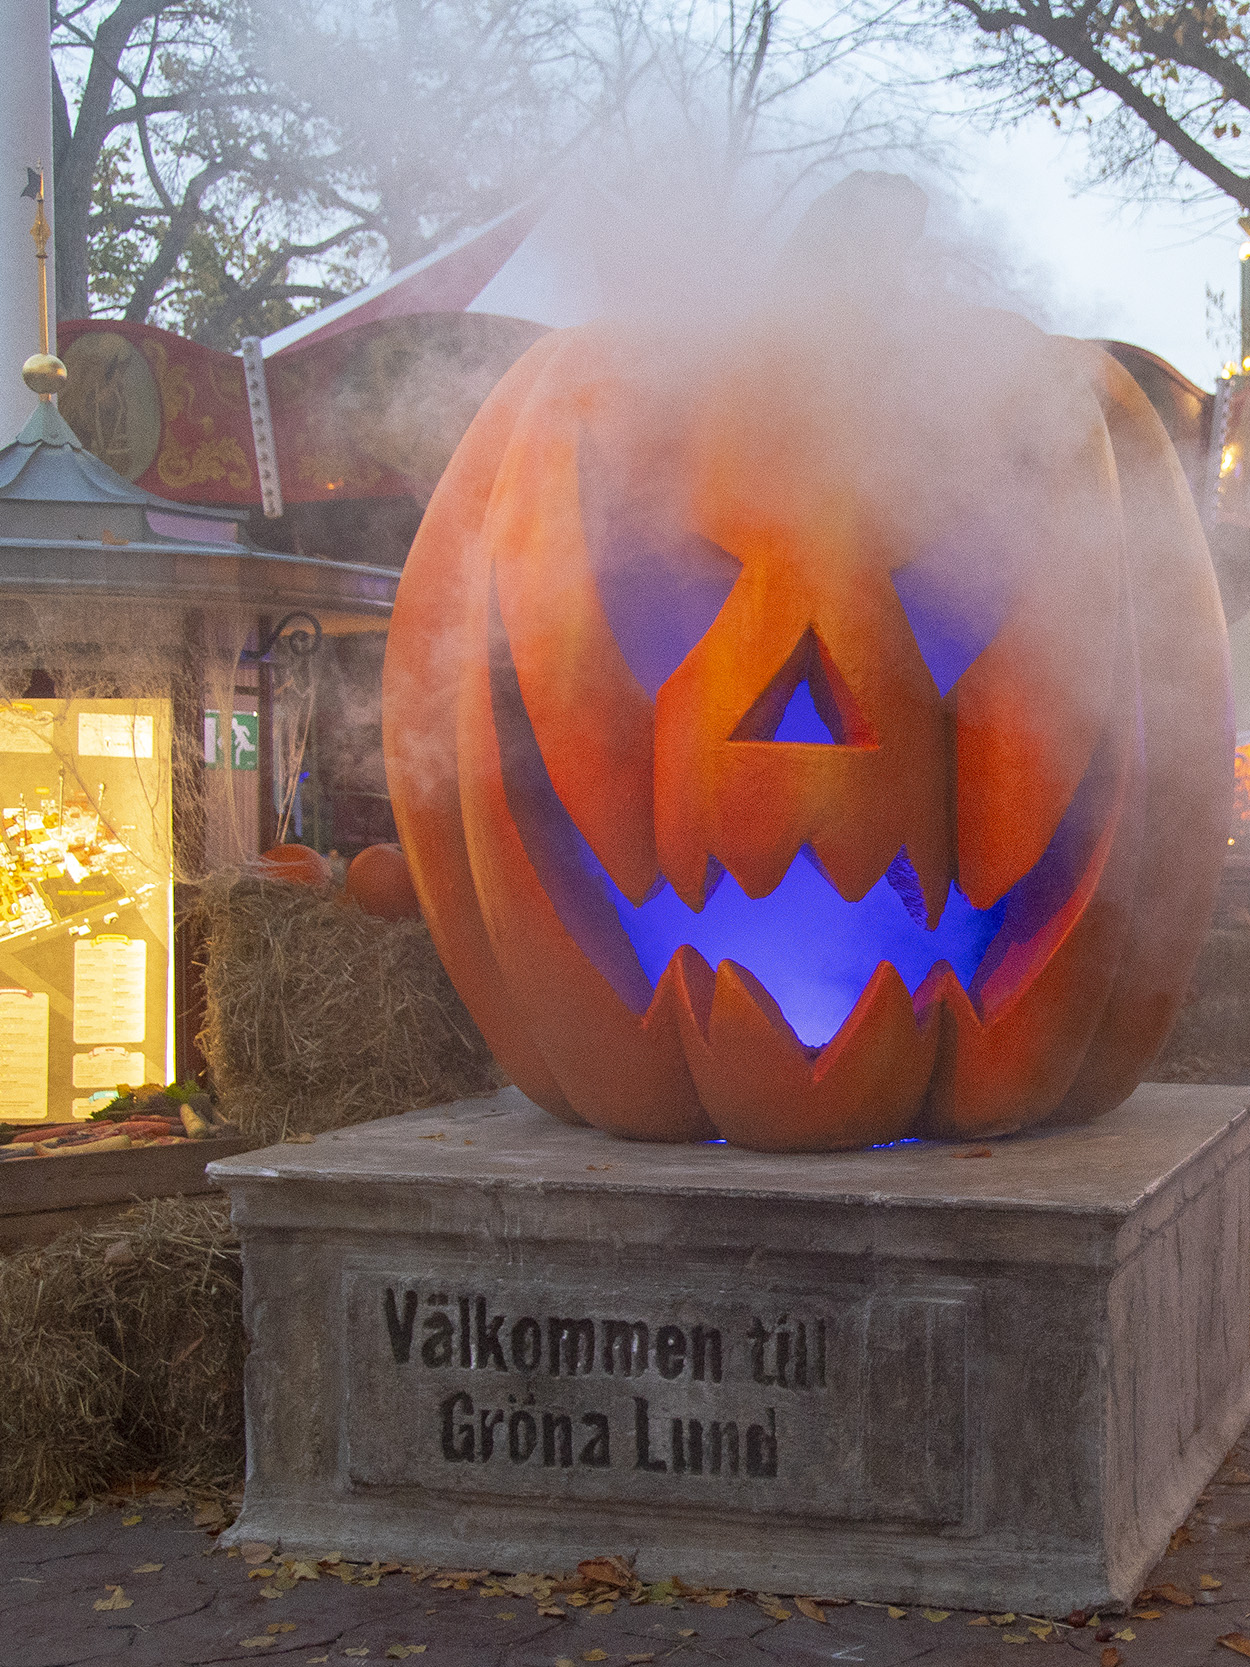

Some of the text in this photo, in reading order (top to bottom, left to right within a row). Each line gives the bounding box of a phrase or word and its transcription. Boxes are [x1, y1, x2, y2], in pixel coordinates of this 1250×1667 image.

[384, 1288, 827, 1388] Välkommen till
[440, 1391, 780, 1479] Gröna Lund
